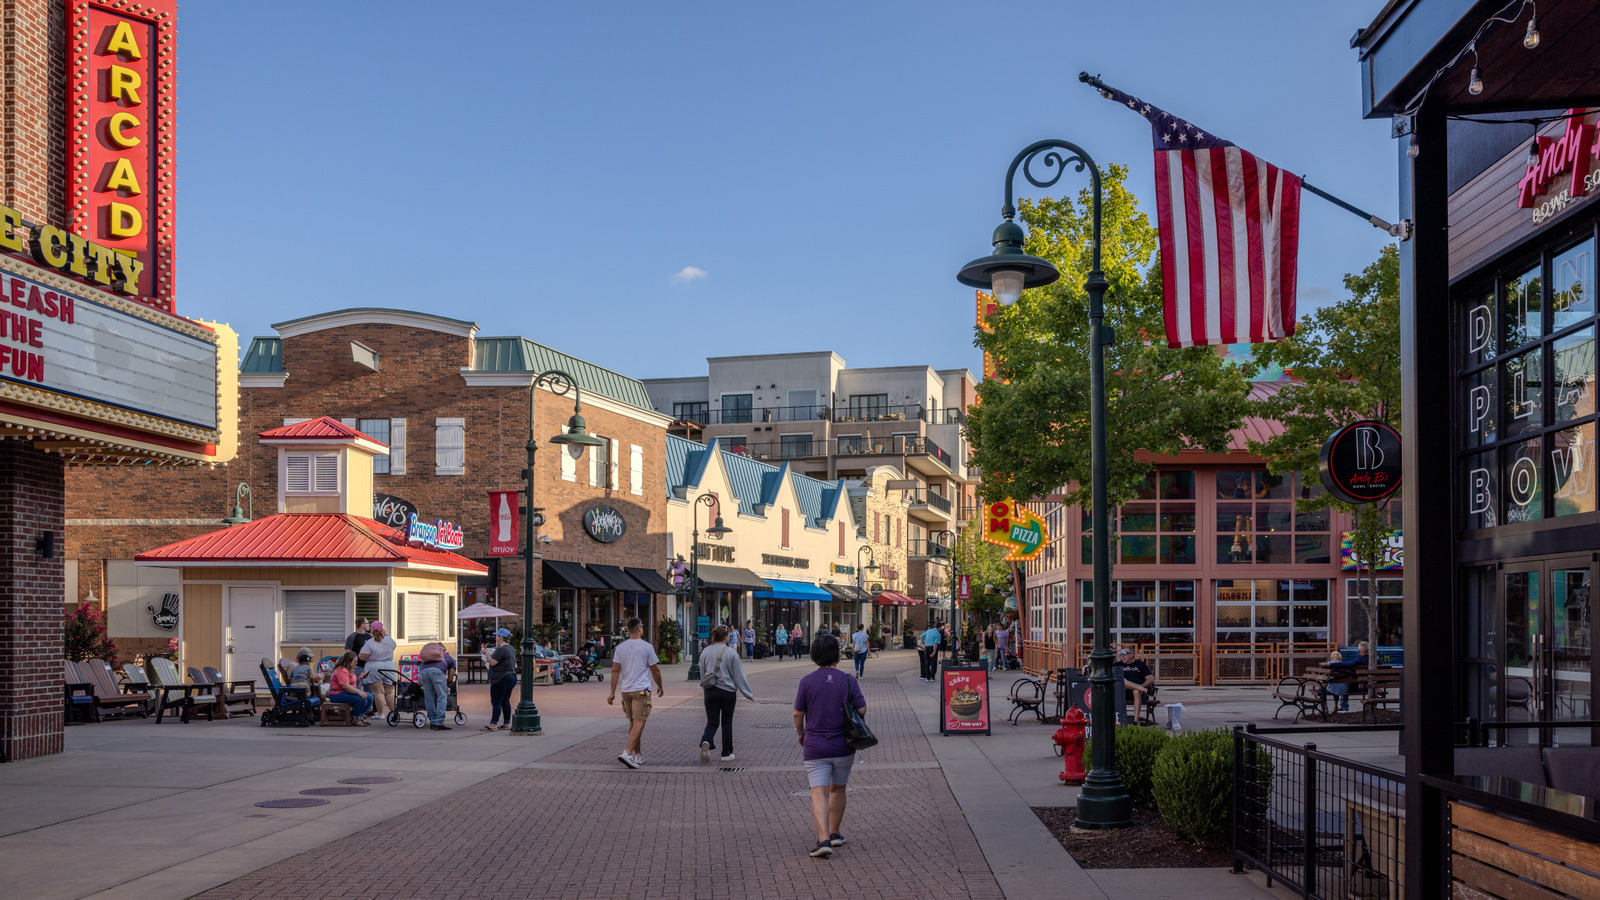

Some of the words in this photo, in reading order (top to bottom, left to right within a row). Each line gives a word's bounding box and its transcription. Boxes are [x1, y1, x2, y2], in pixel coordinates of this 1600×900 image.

[34, 223, 144, 296] CITY
[0, 273, 74, 324] LEASH
[0, 308, 43, 348] THE
[0, 343, 44, 383] FUN
[1349, 471, 1371, 488] Andy
[372, 496, 408, 527] NEYS
[410, 513, 437, 547] Branson
[436, 519, 447, 546] Jet
[446, 521, 464, 547] Boats
[1011, 526, 1039, 545] PIZZA
[492, 545, 515, 554] enjoy
[711, 544, 736, 565] TOPIC
